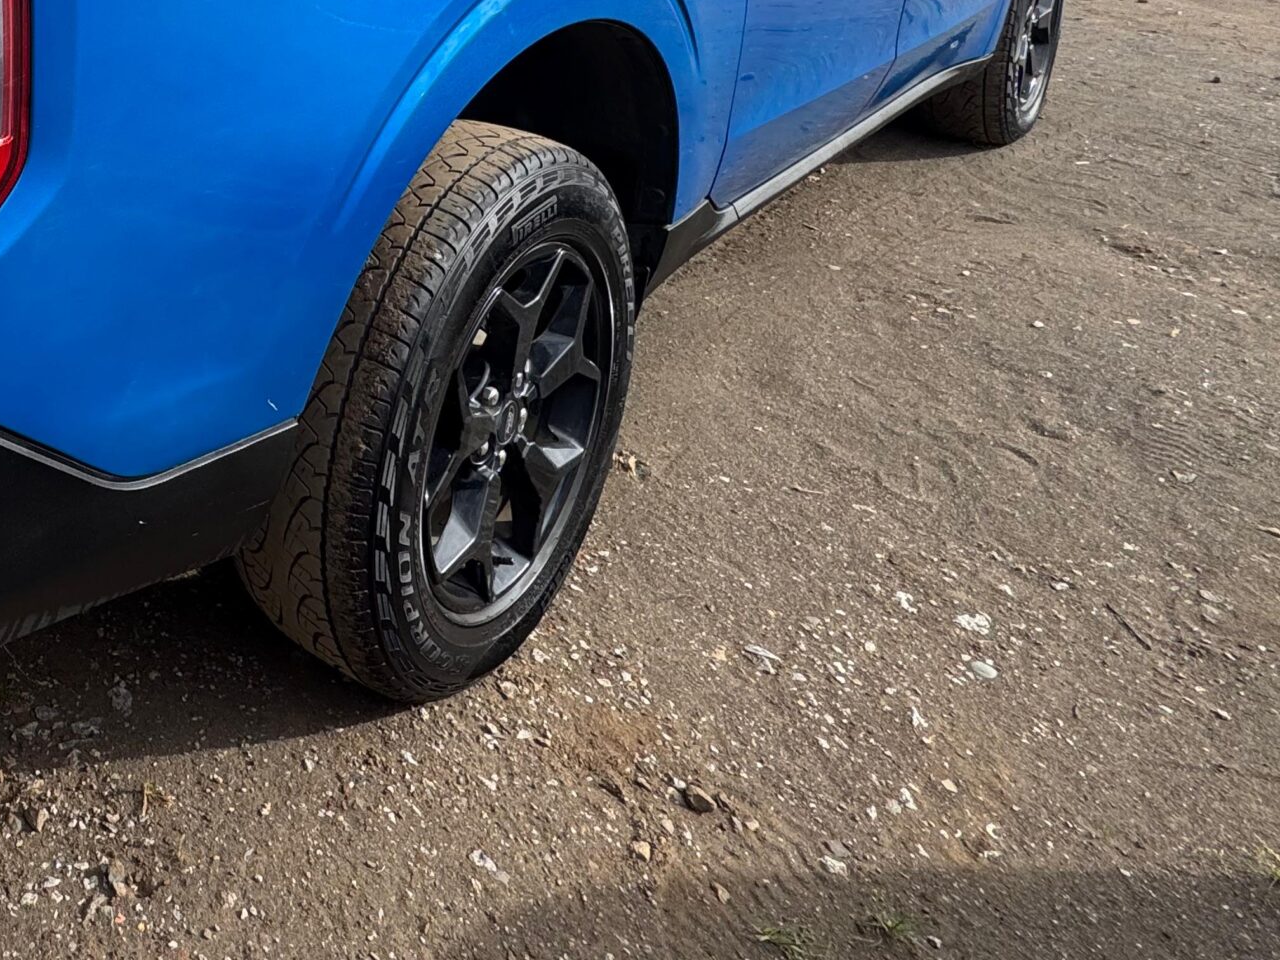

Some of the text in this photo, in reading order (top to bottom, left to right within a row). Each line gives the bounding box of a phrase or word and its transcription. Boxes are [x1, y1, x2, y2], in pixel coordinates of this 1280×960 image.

[511, 194, 559, 249] PIRELLI
[610, 224, 635, 362] PIRELLI
[397, 510, 472, 672] SCORPION
